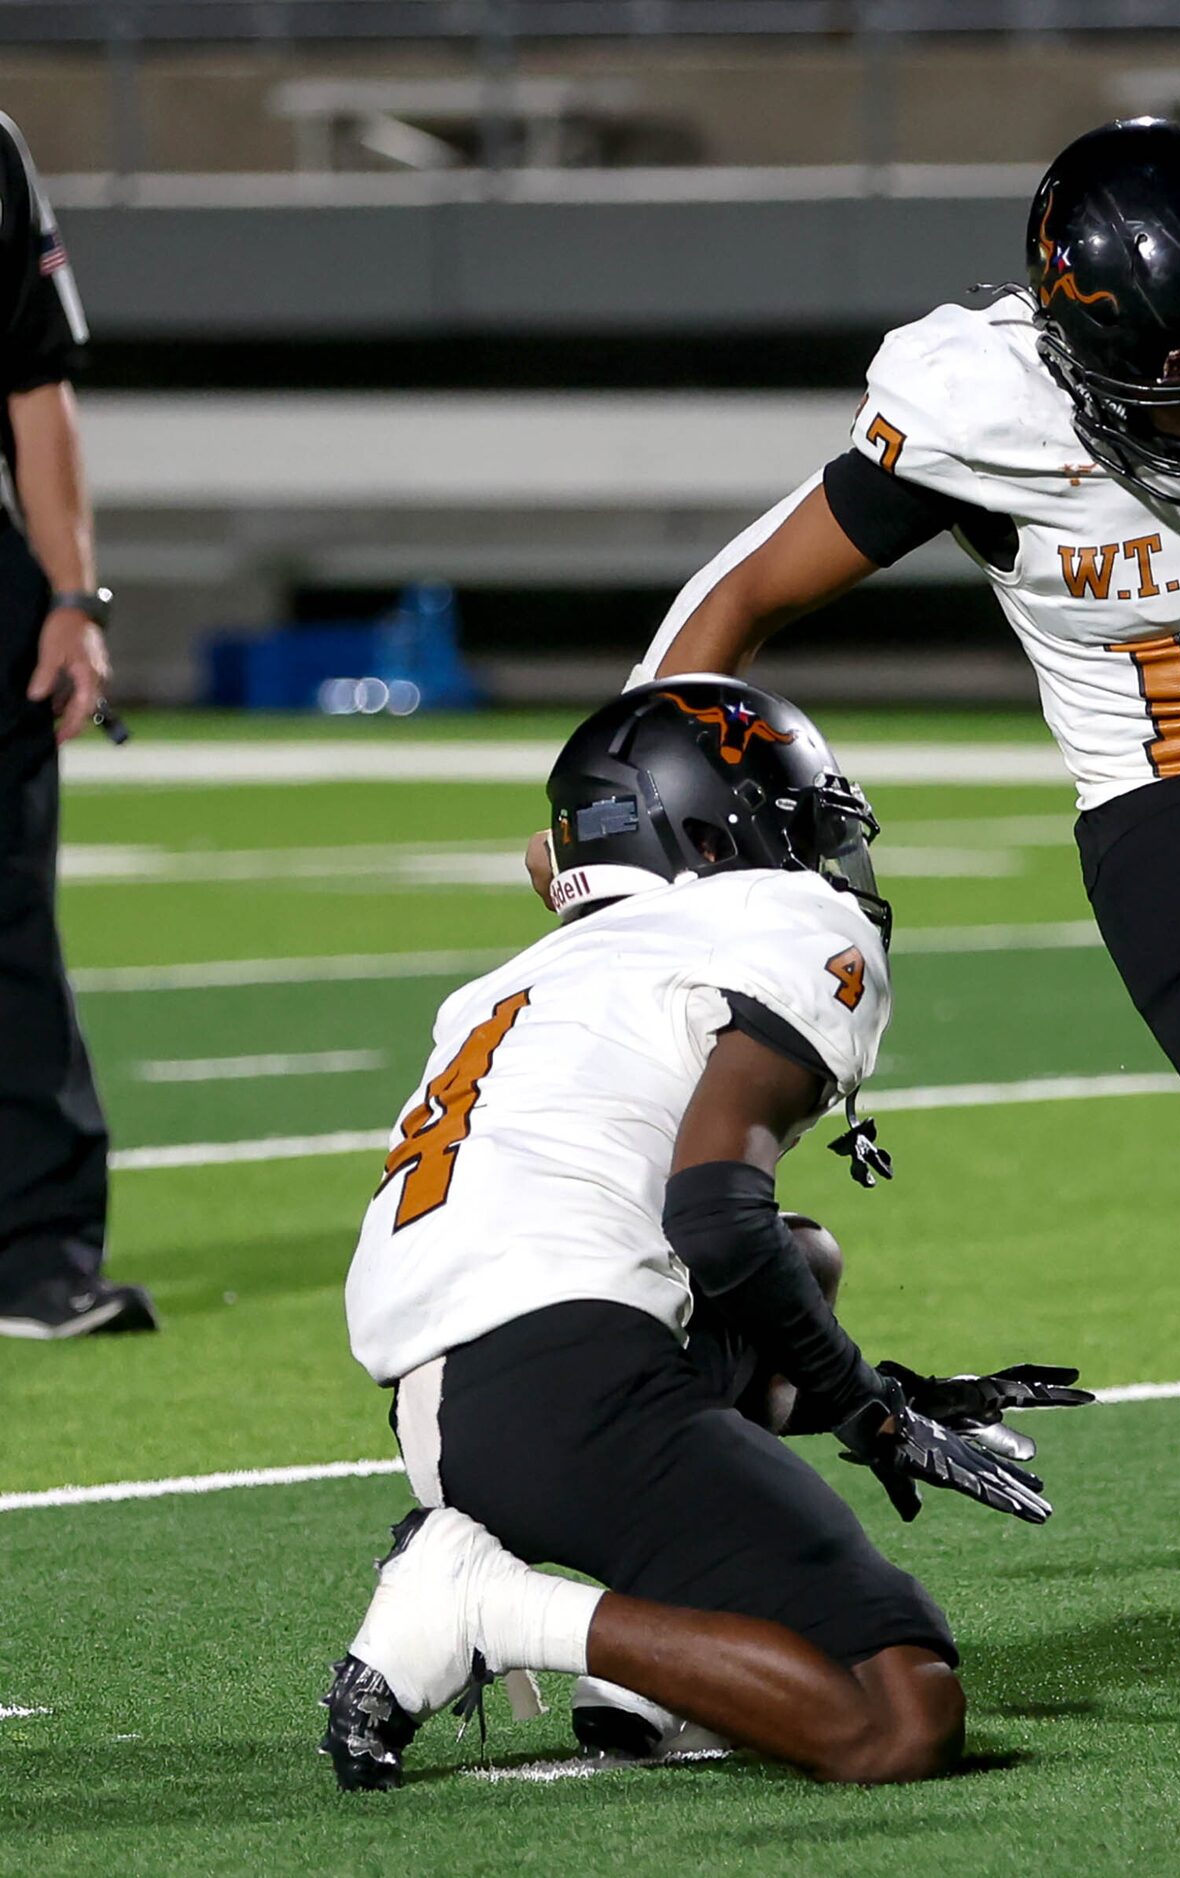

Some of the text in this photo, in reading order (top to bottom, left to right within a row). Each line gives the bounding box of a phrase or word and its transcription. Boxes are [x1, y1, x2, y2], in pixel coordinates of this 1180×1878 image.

[850, 392, 907, 475] 7
[1058, 533, 1180, 600] W.T.
[825, 946, 866, 1012] 4
[374, 985, 534, 1236] 4
